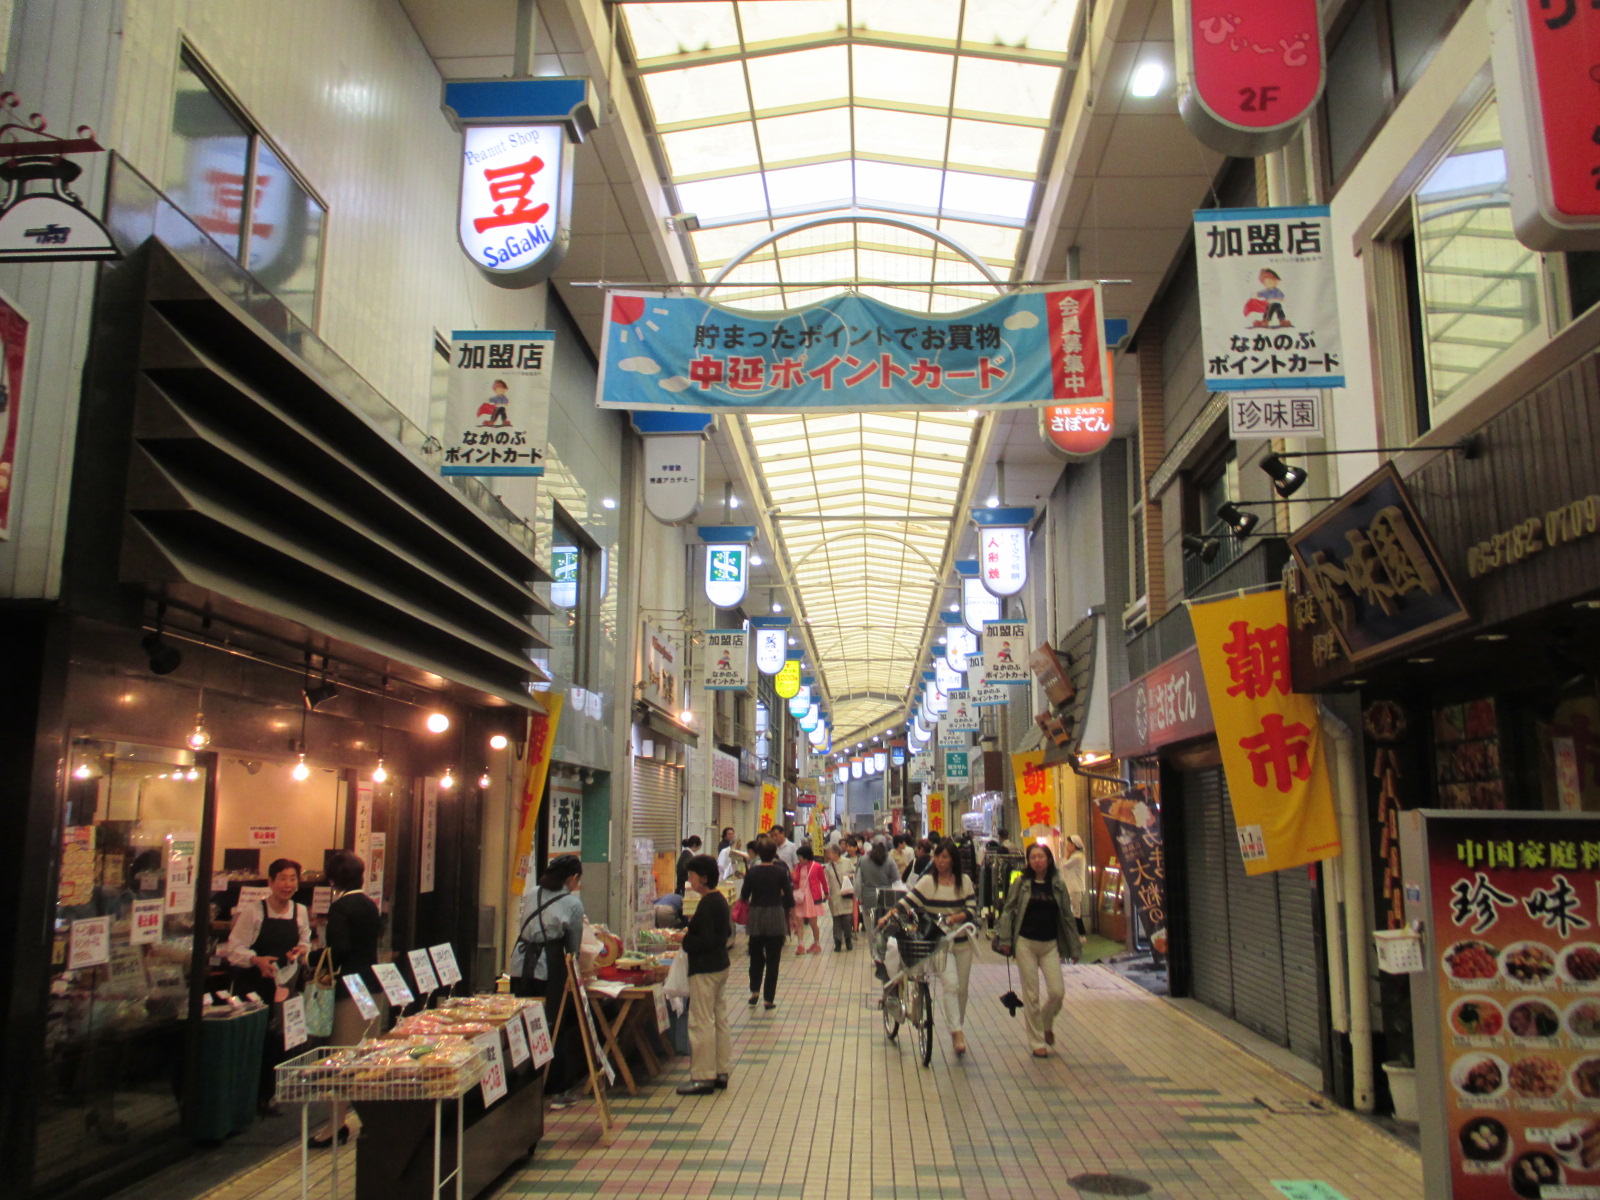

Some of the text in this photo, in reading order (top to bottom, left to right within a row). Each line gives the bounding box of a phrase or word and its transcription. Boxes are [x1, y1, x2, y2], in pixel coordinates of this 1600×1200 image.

[1237, 86, 1280, 112] 2F
[464, 129, 540, 166] Peanut Shop
[473, 155, 550, 234] 豆
[483, 224, 551, 268] SaGaMi
[1207, 221, 1321, 258] 加盟店
[693, 323, 1001, 351] 貯まったポイントでお買物
[1058, 295, 1086, 394] 会員募集中
[1230, 330, 1316, 352] なかのぶ
[458, 343, 544, 369] 加盟店
[1208, 352, 1340, 375] ポイントカード
[688, 352, 1009, 391] 中延ポイントカード
[1050, 415, 1111, 432] さぼてん
[1237, 400, 1315, 430] 珍味園
[462, 430, 527, 445] なかのぶ
[444, 447, 543, 463] ポイントカード
[708, 634, 744, 646] 加盟店
[986, 624, 1025, 637] 加盟店
[705, 678, 745, 686] ポイントカード
[985, 671, 1029, 679] ポイントカード
[1222, 620, 1313, 793] 朝市
[1022, 761, 1050, 826] 朝市
[1457, 839, 1600, 869] 中国家庭料
[1451, 872, 1600, 938] 珍味
